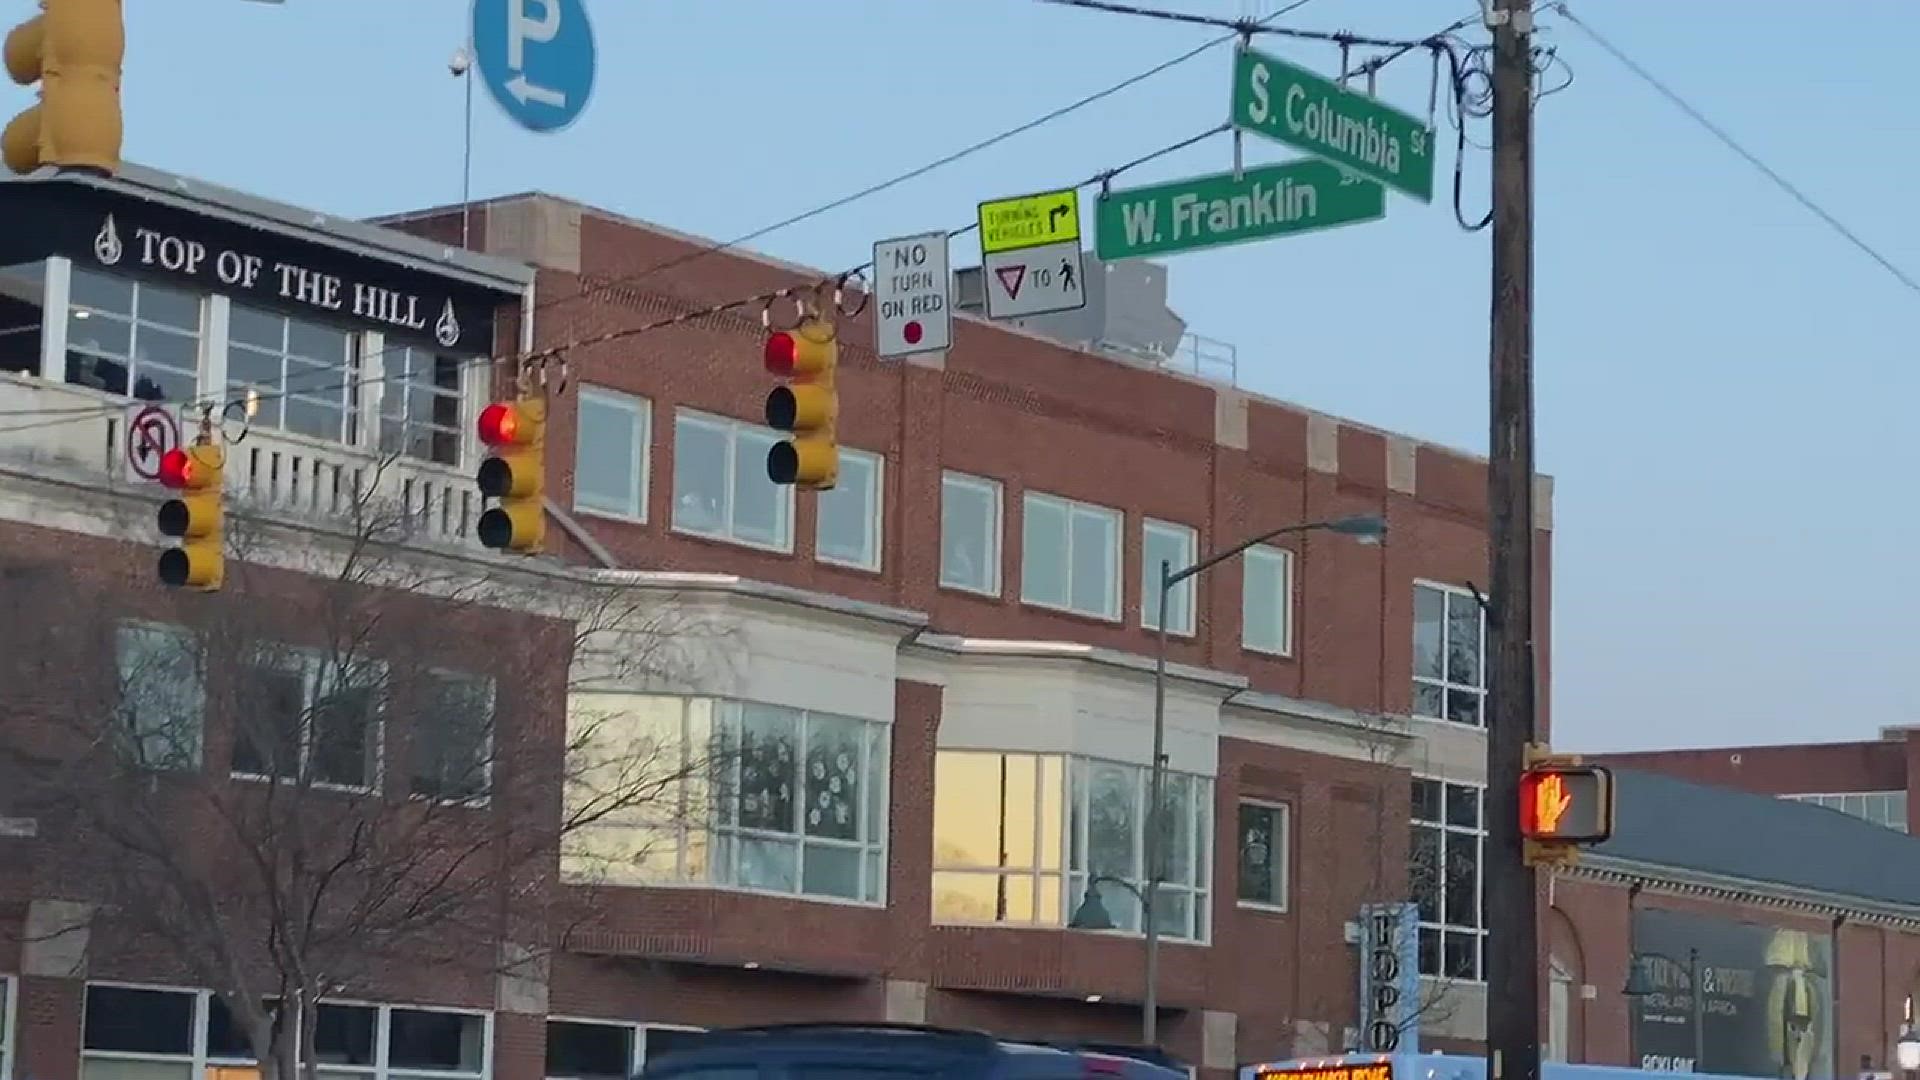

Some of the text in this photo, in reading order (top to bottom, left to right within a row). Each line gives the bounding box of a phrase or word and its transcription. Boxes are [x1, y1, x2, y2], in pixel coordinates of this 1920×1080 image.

[508, 0, 560, 70] P
[1249, 62, 1277, 125] S.
[1286, 83, 1401, 174] Columbia
[1122, 177, 1317, 246] W. Franklin
[136, 228, 426, 329] TOP OF THE HILL
[895, 244, 926, 268] NO
[1031, 270, 1050, 288] TO
[891, 271, 933, 294] TURN
[882, 294, 942, 320] ON RED
